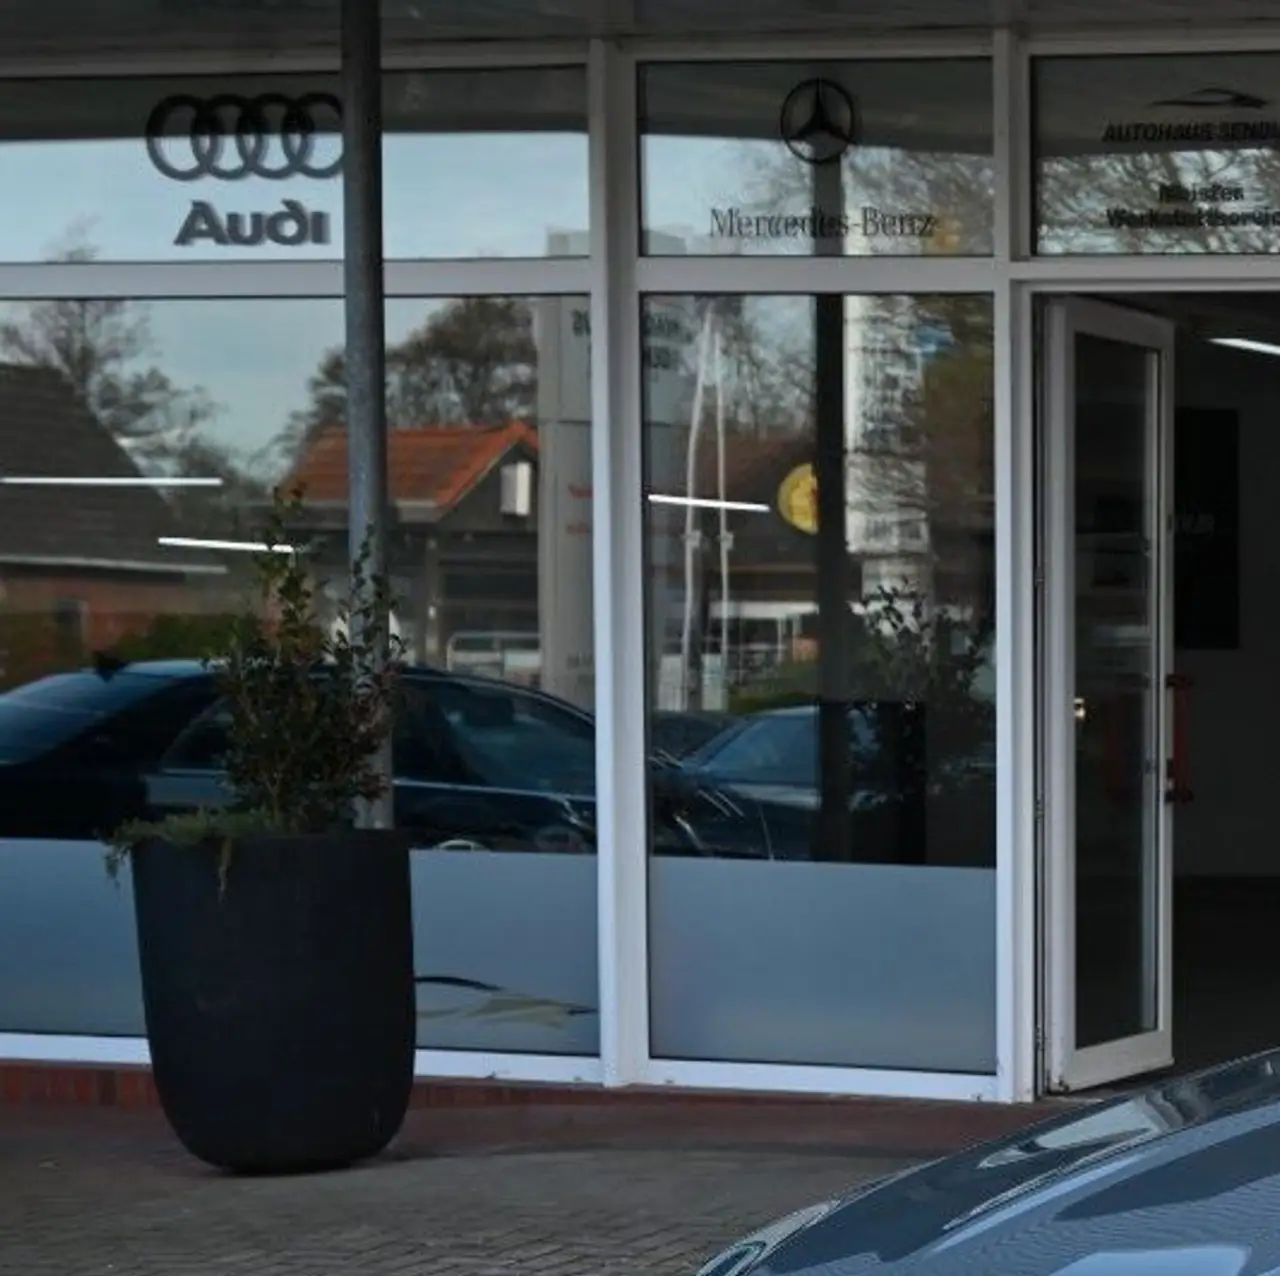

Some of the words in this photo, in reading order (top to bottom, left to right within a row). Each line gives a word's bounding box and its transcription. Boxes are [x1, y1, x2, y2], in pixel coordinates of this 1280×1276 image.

[1102, 120, 1212, 143] AUTOHAUS
[173, 198, 331, 246] Audi
[710, 206, 935, 239] Mercedes-Benz
